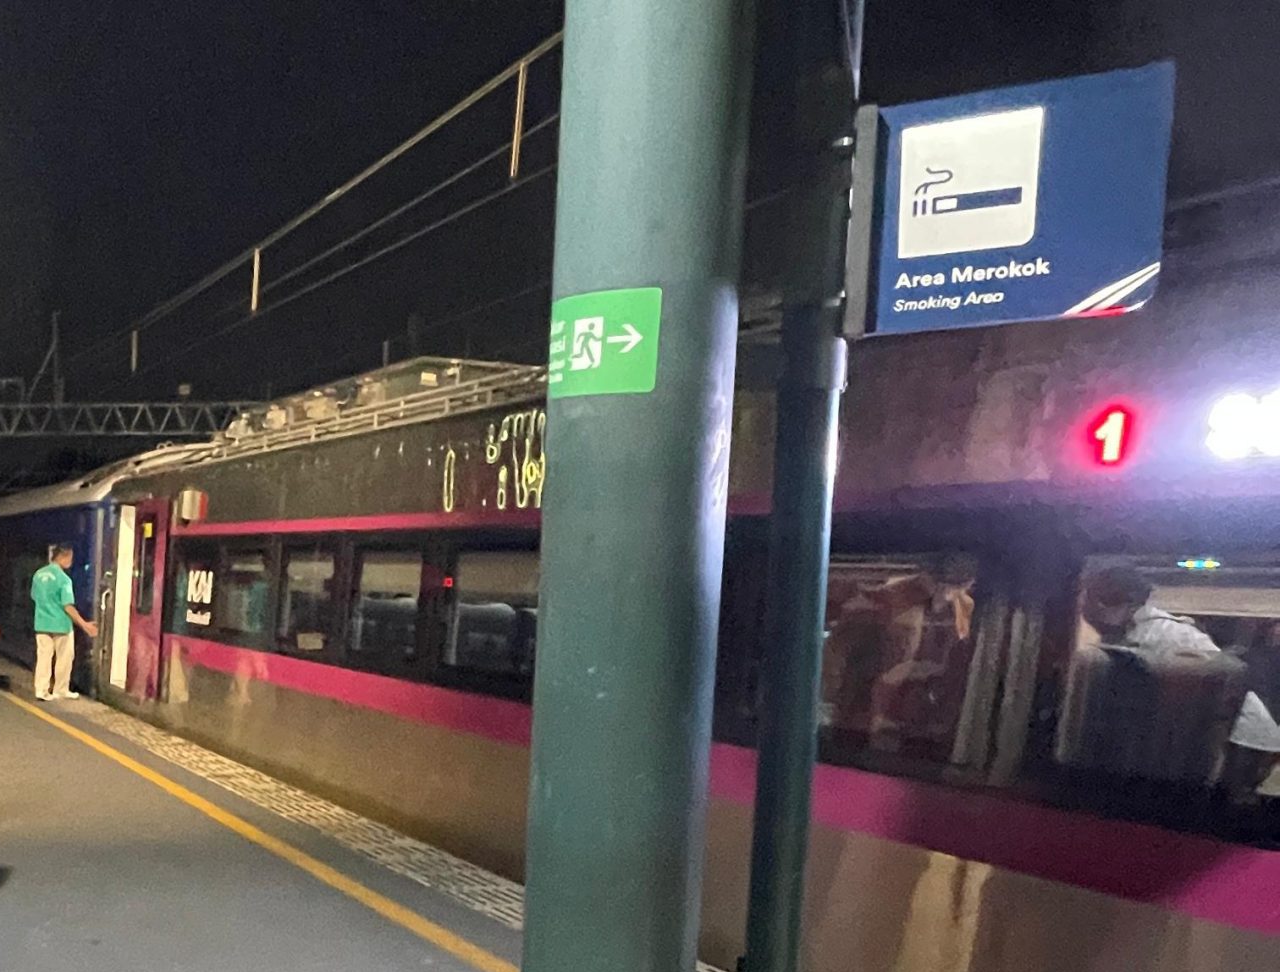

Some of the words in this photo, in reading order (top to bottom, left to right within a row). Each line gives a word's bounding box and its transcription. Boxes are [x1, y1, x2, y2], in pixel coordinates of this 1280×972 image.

[894, 271, 945, 289] Area
[951, 257, 1051, 284] Merokok
[893, 295, 962, 313] Smoking
[964, 291, 1005, 306] Area
[1094, 410, 1125, 461] 1
